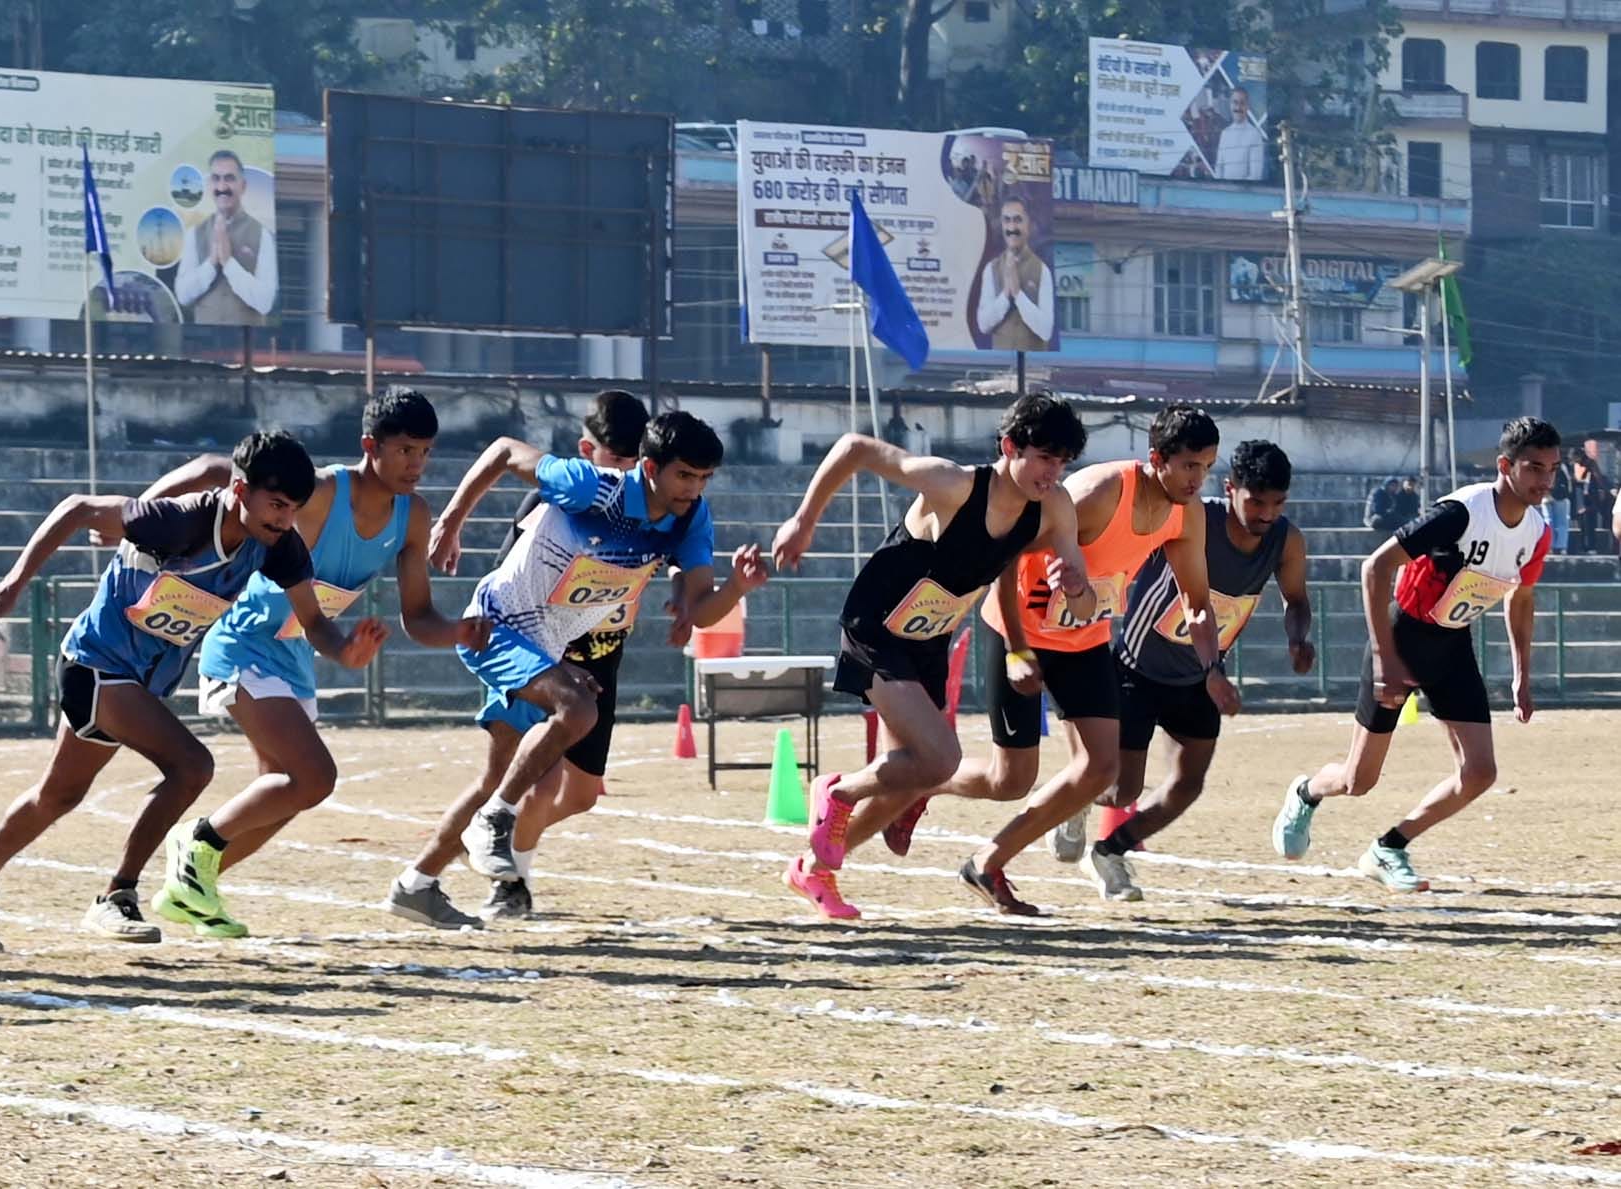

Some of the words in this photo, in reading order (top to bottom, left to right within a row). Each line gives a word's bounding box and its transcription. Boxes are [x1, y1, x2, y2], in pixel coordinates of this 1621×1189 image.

[234, 104, 274, 129] साल
[16, 122, 34, 145] को
[37, 126, 73, 147] बचाने
[96, 129, 130, 155] लड़ाई
[133, 131, 163, 155] जारी
[751, 147, 792, 175] युवाओं
[793, 147, 811, 171] की
[858, 156, 874, 173] का
[876, 152, 907, 176] इंजन
[753, 180, 784, 200] 680
[785, 177, 821, 205] करोड़
[823, 178, 842, 203] की
[868, 179, 909, 206] सौगात
[1077, 168, 1139, 204] MANDI
[1306, 258, 1377, 281] DIGITAL
[1465, 540, 1490, 567] 19
[568, 586, 630, 604] 029
